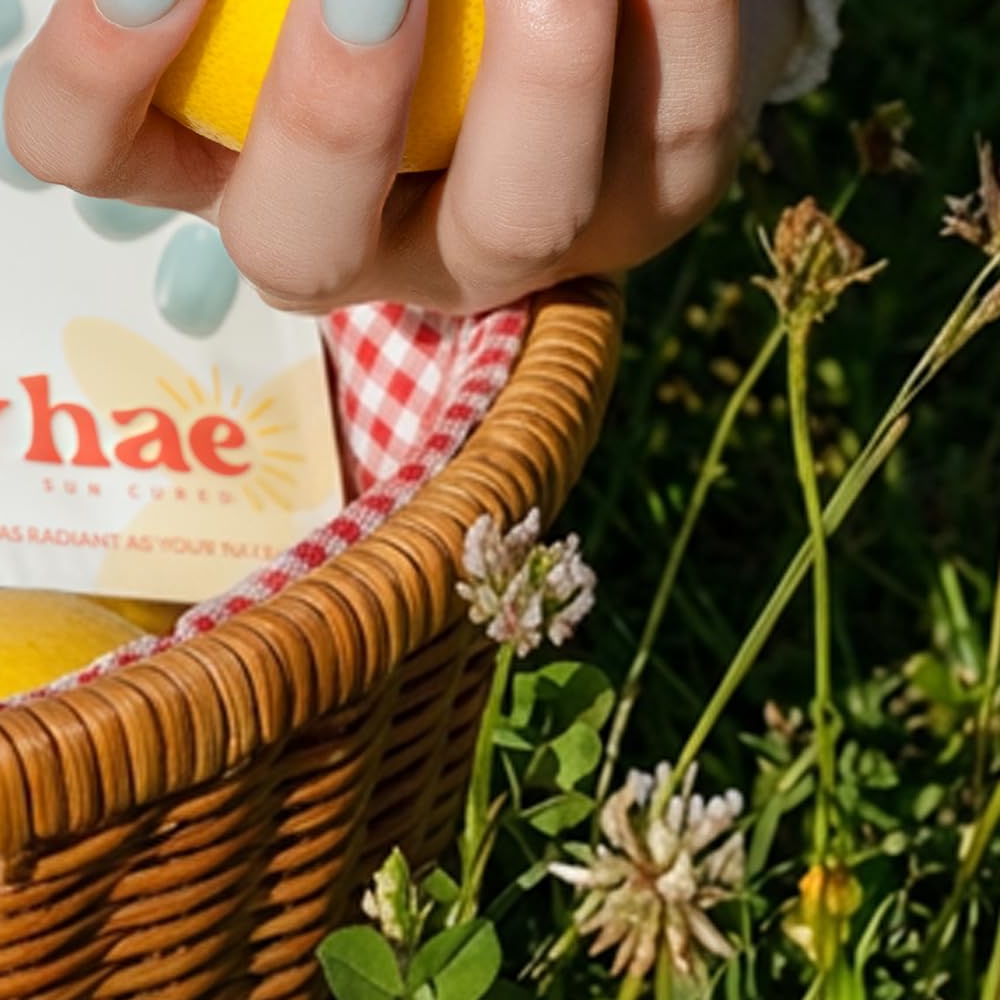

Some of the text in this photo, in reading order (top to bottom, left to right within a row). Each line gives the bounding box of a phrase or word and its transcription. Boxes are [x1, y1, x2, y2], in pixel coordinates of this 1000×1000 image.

[43, 477, 235, 505] SUN CURED
[27, 527, 120, 550] RADIANT
[125, 536, 153, 553] AS
